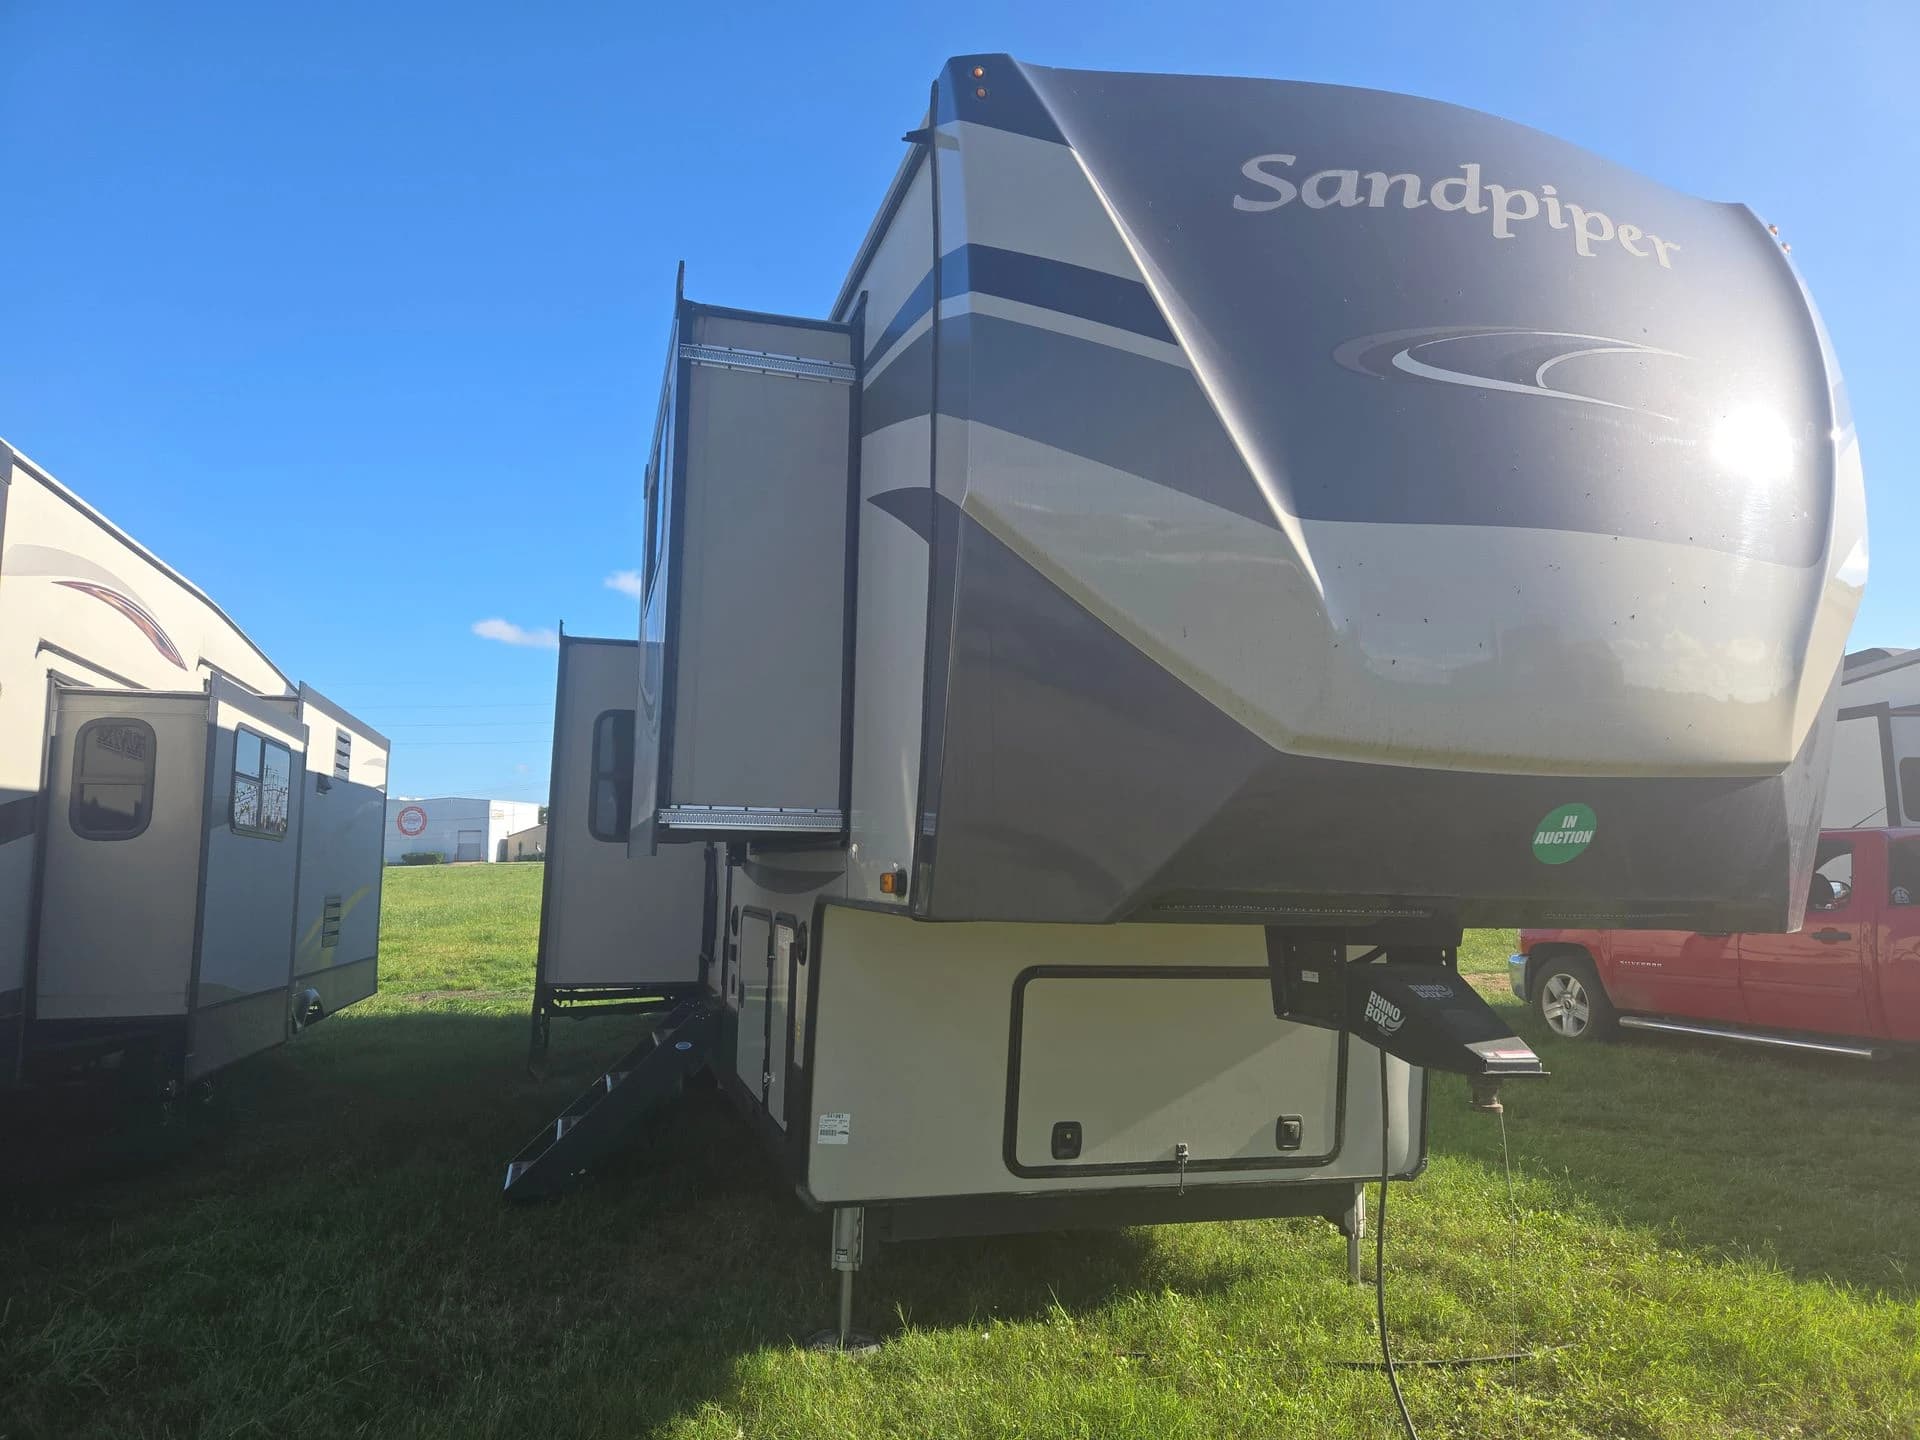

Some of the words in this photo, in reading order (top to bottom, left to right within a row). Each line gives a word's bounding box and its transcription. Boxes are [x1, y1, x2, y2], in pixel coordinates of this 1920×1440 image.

[1233, 154, 1681, 269] Sandpiper
[1562, 815, 1578, 829] IN
[1534, 830, 1593, 845] AUCTION
[1365, 1002, 1389, 1028] BOX
[1369, 991, 1401, 1021] RHINO
